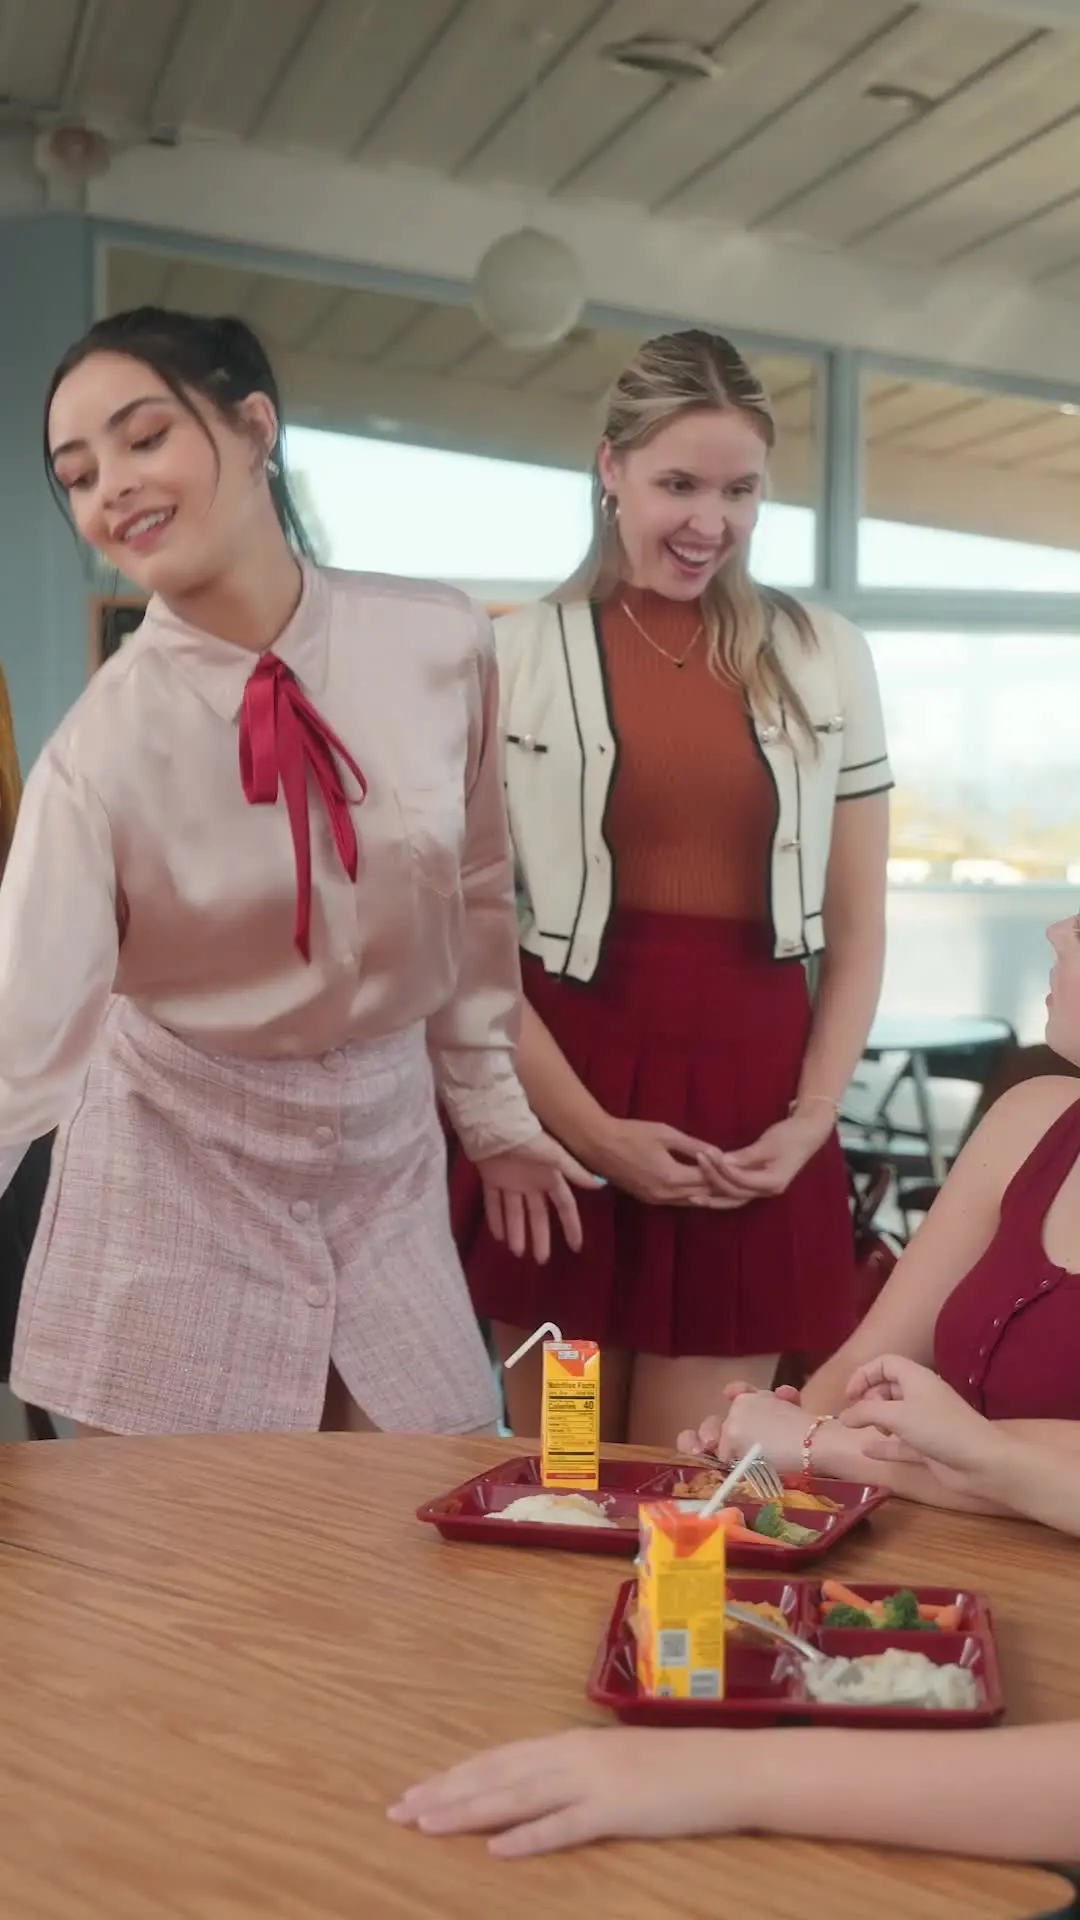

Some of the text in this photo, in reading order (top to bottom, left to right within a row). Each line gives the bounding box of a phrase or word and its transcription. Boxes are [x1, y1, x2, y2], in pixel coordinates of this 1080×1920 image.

[548, 1381, 595, 1390] Nutrition Facts
[548, 1400, 594, 1410] Calories 40
